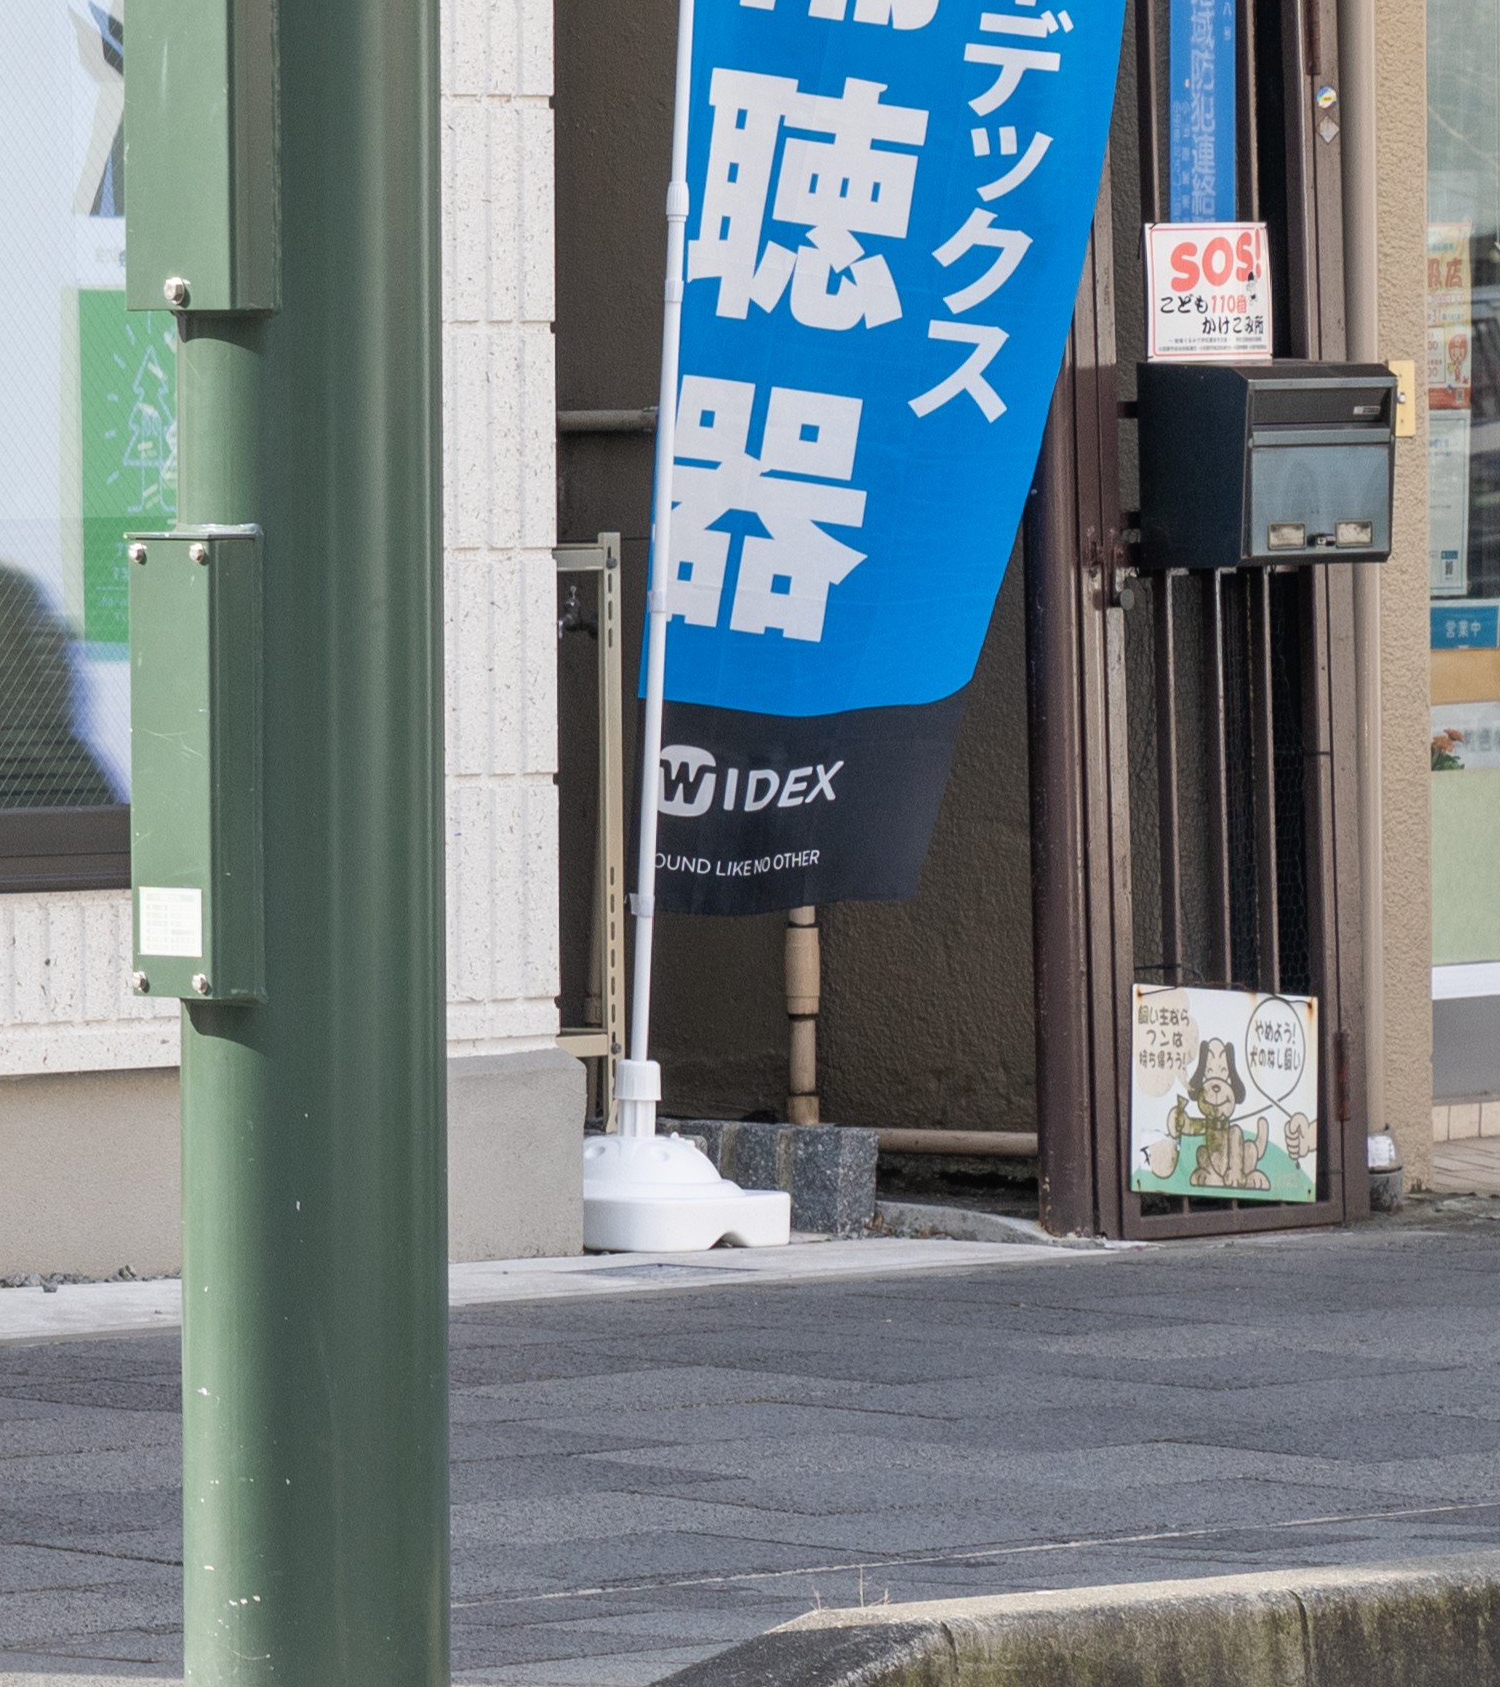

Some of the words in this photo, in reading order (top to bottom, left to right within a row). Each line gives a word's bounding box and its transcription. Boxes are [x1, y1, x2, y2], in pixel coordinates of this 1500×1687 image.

[1170, 229, 1262, 293] SOS!
[1202, 316, 1264, 335] かけこみ所
[1445, 619, 1481, 639] 営業中
[657, 744, 845, 817] WIDEX
[655, 852, 711, 875] OUND
[715, 860, 752, 877] LIKE
[753, 856, 771, 874] NO
[772, 849, 820, 870] OTHER
[1138, 1005, 1190, 1027] 飼い主なら
[1146, 1029, 1183, 1048] フンは
[1255, 1019, 1296, 1045] やめよう!
